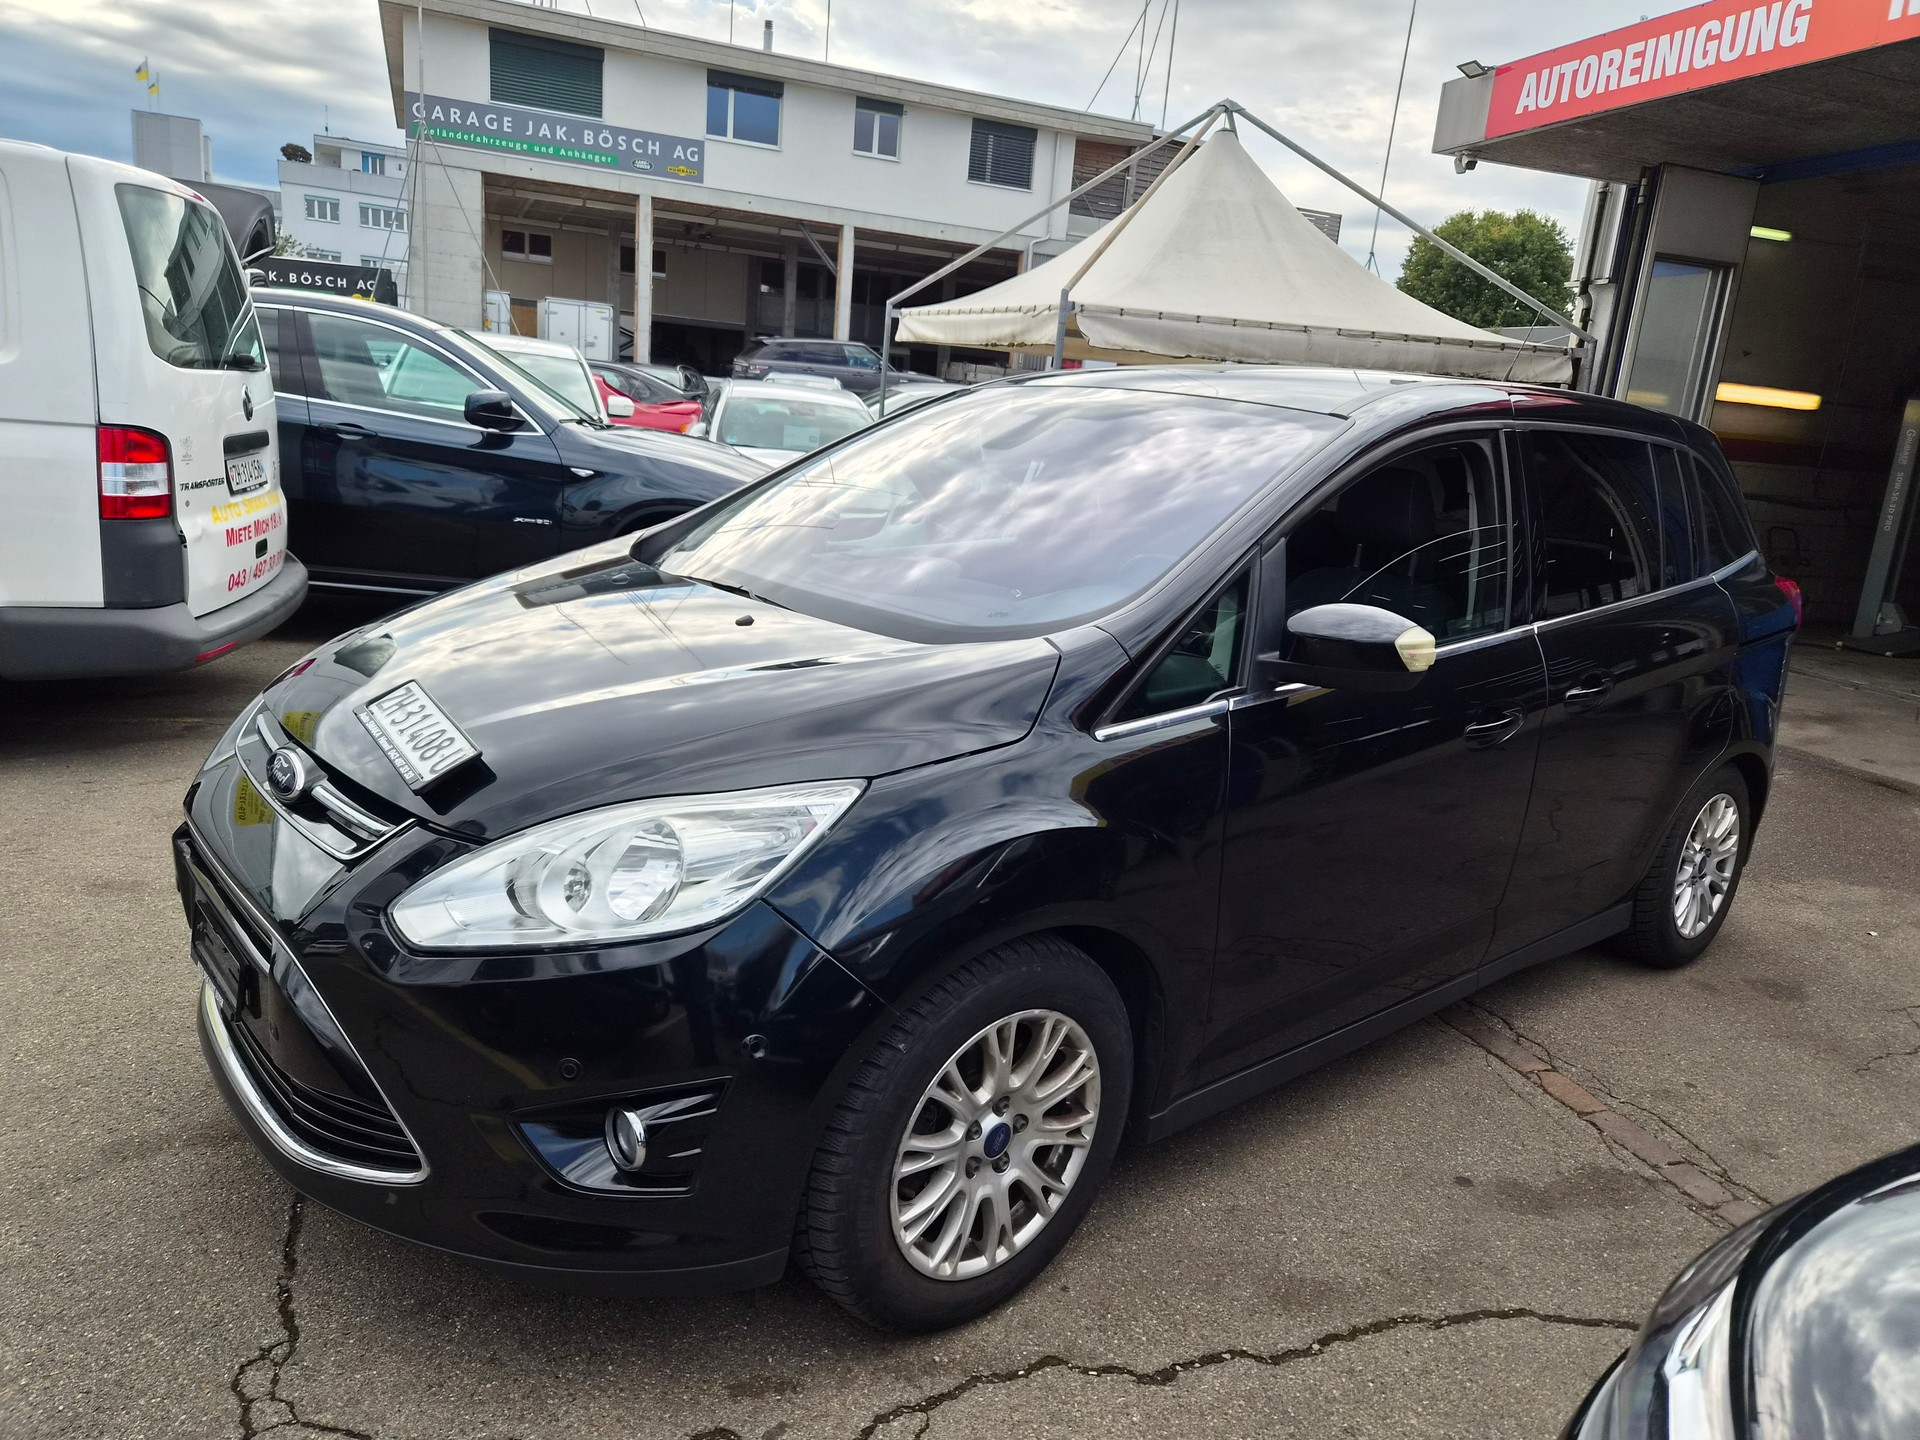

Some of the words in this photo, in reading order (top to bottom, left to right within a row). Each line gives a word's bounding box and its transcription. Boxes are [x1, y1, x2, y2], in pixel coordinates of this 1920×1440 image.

[1515, 0, 1813, 115] AUTOREINIGUNG
[412, 101, 512, 132] GARAGE
[526, 120, 575, 143] JAK.
[584, 129, 660, 156] BÖSCH
[673, 145, 699, 162] AG
[534, 145, 554, 155] und
[560, 148, 612, 163] Anhänger
[289, 272, 347, 289] BÖSCH
[357, 279, 376, 291] AG
[180, 477, 225, 491] TRANSPORTER
[228, 568, 247, 592] 043
[253, 559, 267, 580] 497
